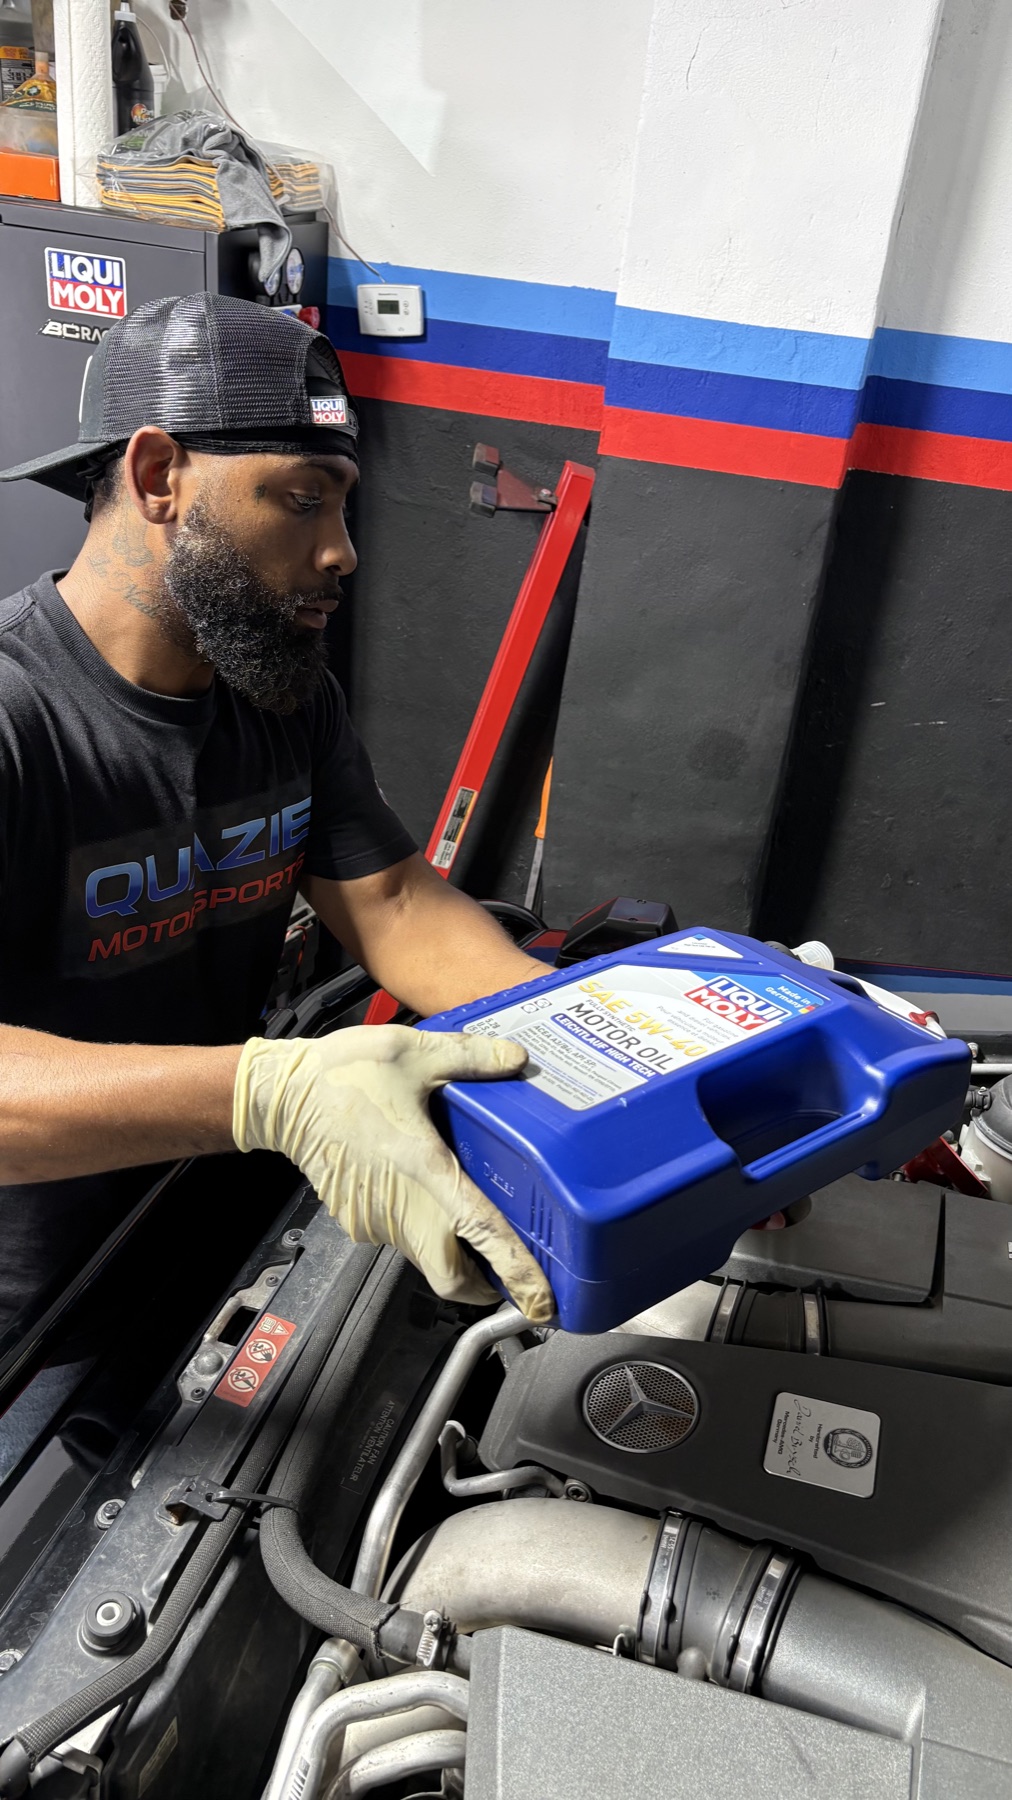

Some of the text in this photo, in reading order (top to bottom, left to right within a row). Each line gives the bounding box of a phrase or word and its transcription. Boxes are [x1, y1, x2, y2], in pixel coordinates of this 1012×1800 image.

[51, 252, 121, 287] LIQUI
[53, 280, 123, 314] MOLY
[312, 401, 343, 411] LIQUI
[313, 411, 344, 422] MOLY
[688, 987, 767, 1028] MOLY
[708, 979, 785, 1021] LIQUI
[765, 986, 804, 1009] Germany
[777, 985, 811, 1005] Made in
[578, 979, 708, 1057] SAE 5W-40
[585, 999, 636, 1032] FULLY SYNTHETIC
[531, 1024, 553, 1038] ACEA
[571, 1051, 586, 1060] API
[554, 1013, 609, 1053] LEICHTLAUF
[604, 1046, 631, 1064] HIGH
[628, 1058, 656, 1078] TECH
[566, 1002, 673, 1070] MOTOR OIL
[373, 1400, 395, 1433] ATTENTION
[375, 1418, 394, 1448] CAUTION
[773, 1418, 782, 1443] Germany
[778, 1410, 790, 1455] Mercedes-AMG
[808, 1435, 815, 1443] by
[813, 1423, 823, 1459] Handcrafted
[350, 1435, 378, 1481] VENTILATEUR
[367, 1448, 380, 1465] FAN
